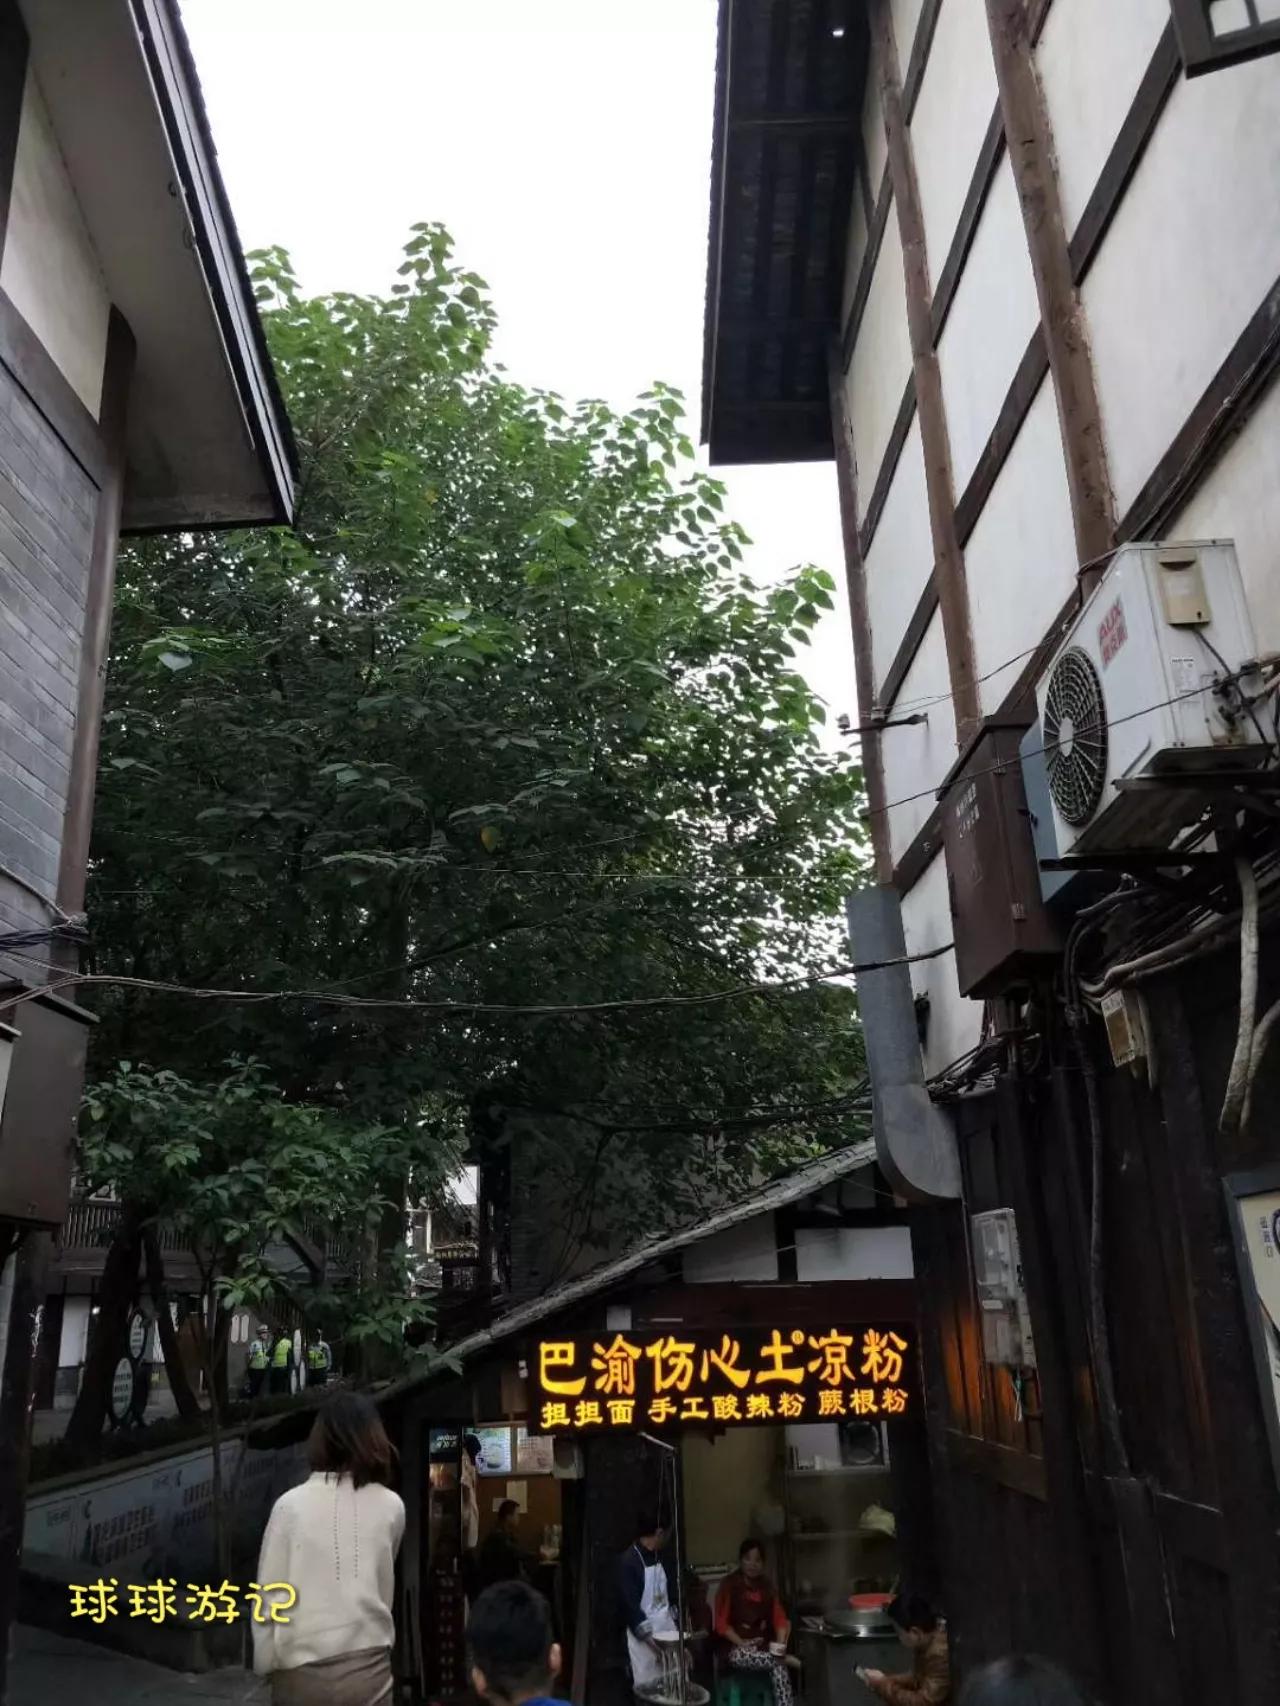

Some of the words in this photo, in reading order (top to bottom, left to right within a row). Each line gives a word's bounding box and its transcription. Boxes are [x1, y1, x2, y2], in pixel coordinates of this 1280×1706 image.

[540, 1400, 636, 1430] 担担面
[648, 1391, 806, 1423] 手工酸辣粉
[818, 1388, 909, 1416] 蕨根粉
